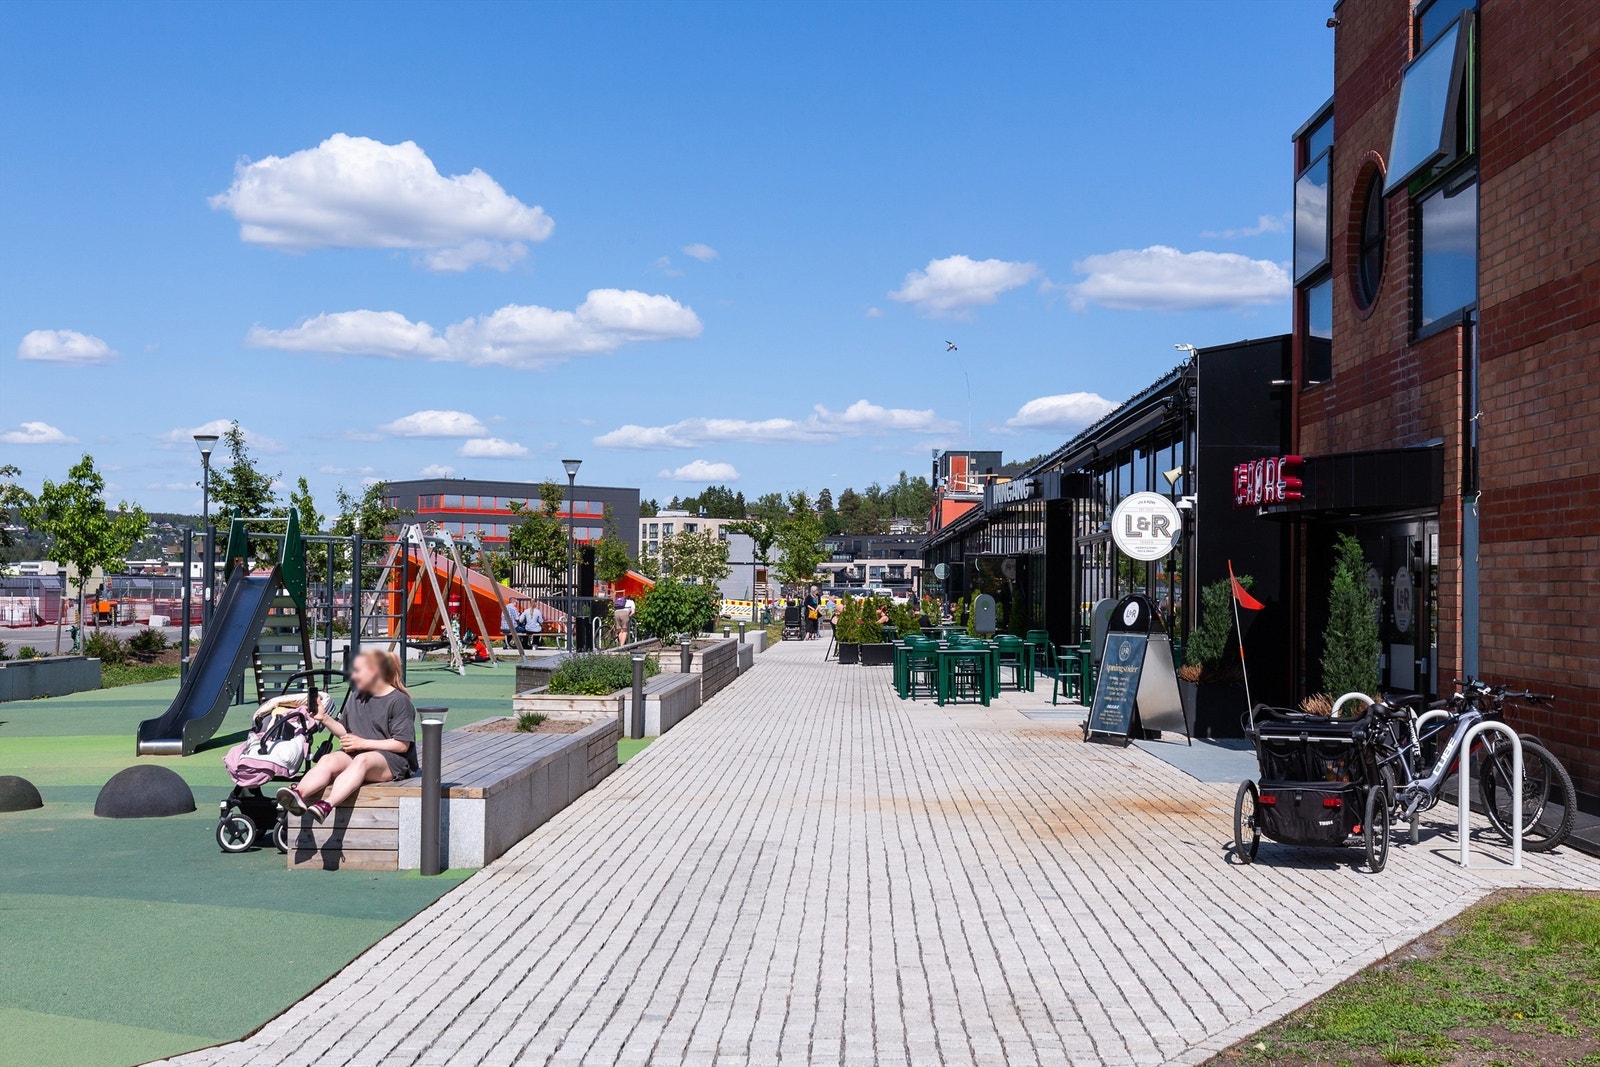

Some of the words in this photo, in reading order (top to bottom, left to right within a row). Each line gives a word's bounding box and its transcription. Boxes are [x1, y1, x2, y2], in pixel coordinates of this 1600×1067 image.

[993, 478, 1031, 504] INNGANG
[1125, 514, 1172, 538] L&R
[1396, 587, 1410, 611] L&R
[1126, 609, 1137, 618] L&R
[1432, 736, 1457, 777] CUBE
